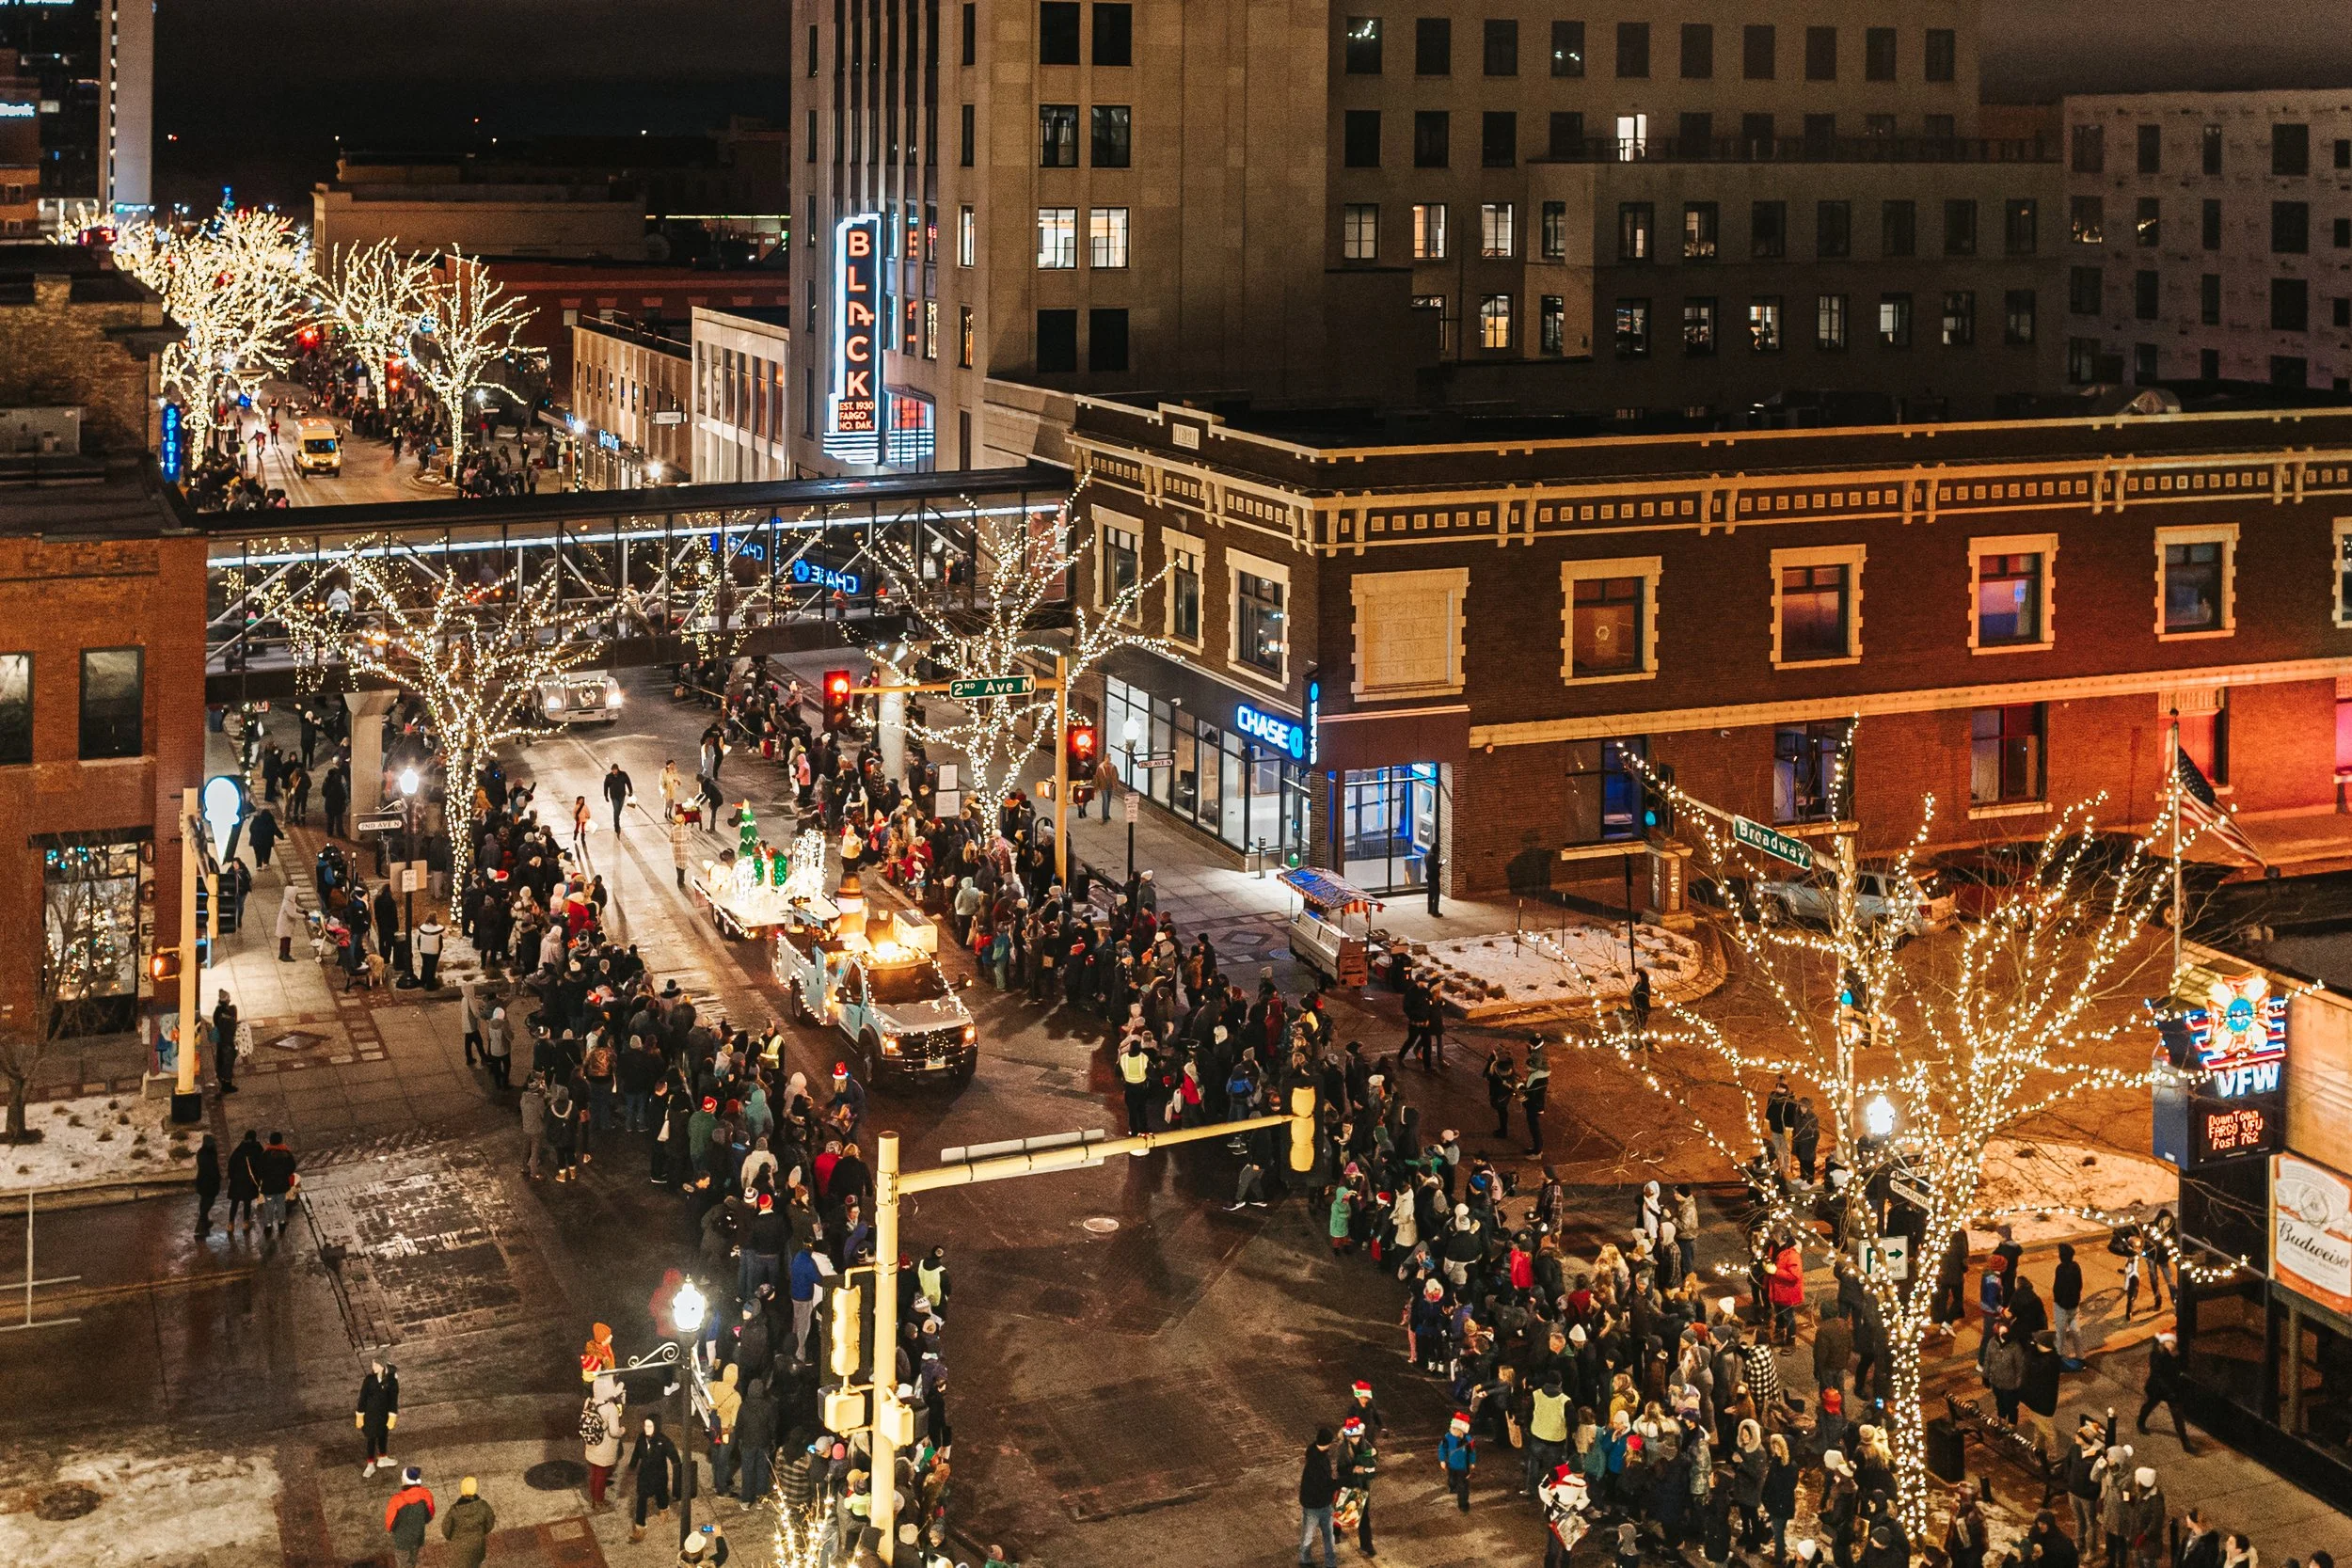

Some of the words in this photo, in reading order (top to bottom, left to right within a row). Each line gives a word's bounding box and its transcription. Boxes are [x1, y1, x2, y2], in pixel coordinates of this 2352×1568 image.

[846, 230, 875, 397] BLACK
[839, 403, 854, 411] EST.
[855, 401, 874, 410] 1930
[839, 411, 867, 420] FARGO
[839, 421, 853, 430] NO.
[855, 420, 874, 430] DAK.
[167, 408, 177, 474] SPIRIT
[954, 682, 976, 696] 2ND
[984, 681, 1014, 693] Ave
[1022, 678, 1033, 691] N
[1237, 705, 1290, 750] CHASE
[1739, 819, 1806, 866] Broadway
[2217, 1062, 2280, 1098] VFW
[2208, 1110, 2259, 1127] DownTown
[2208, 1123, 2238, 1139] FARGO
[2213, 1135, 2236, 1150] Post
[2240, 1132, 2259, 1146] 762
[1892, 1181, 1931, 1209] BROADWA
[2280, 1222, 2350, 1269] Budweiser
